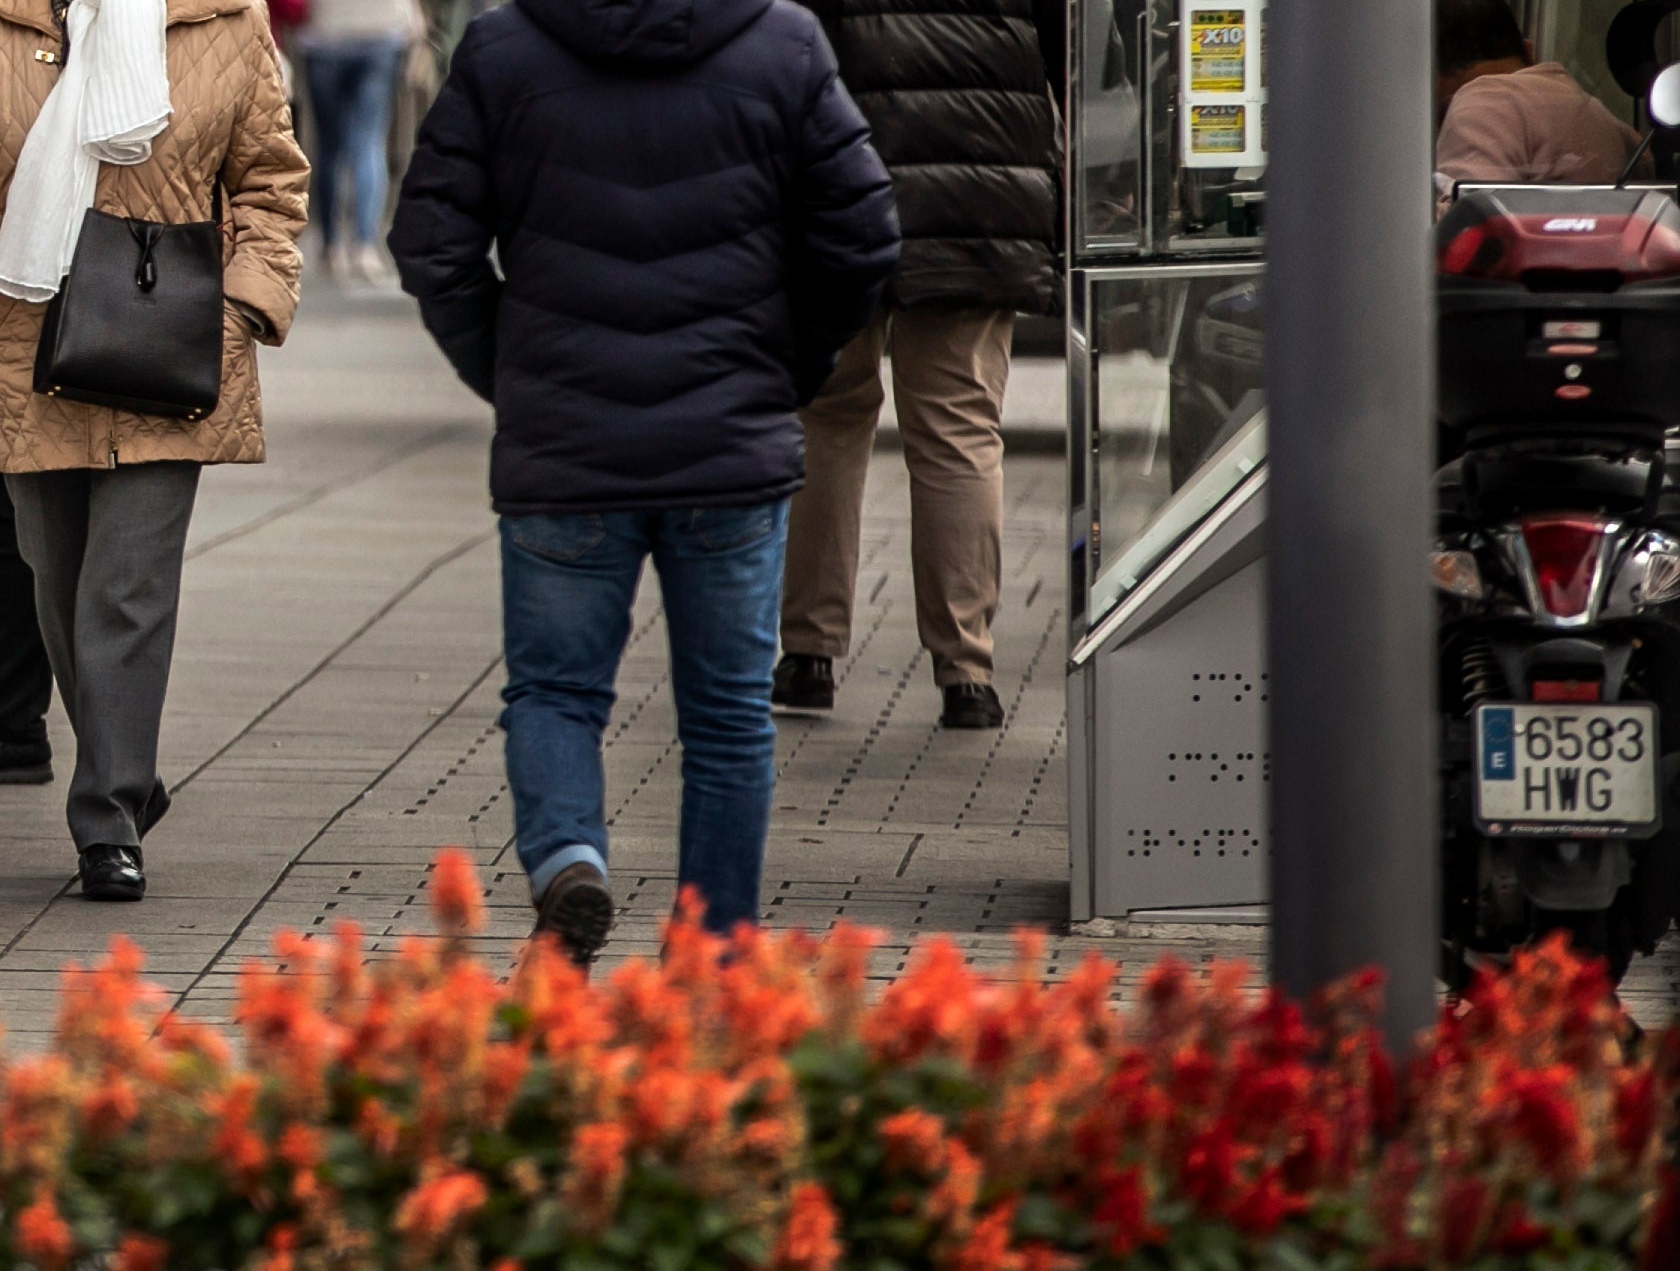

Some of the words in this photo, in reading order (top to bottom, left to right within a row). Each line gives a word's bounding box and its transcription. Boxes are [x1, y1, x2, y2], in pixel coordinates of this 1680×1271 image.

[1203, 28, 1244, 44] X10
[1525, 715, 1645, 762] 6583
[1491, 752, 1506, 769] E
[1524, 766, 1614, 813] HWG
